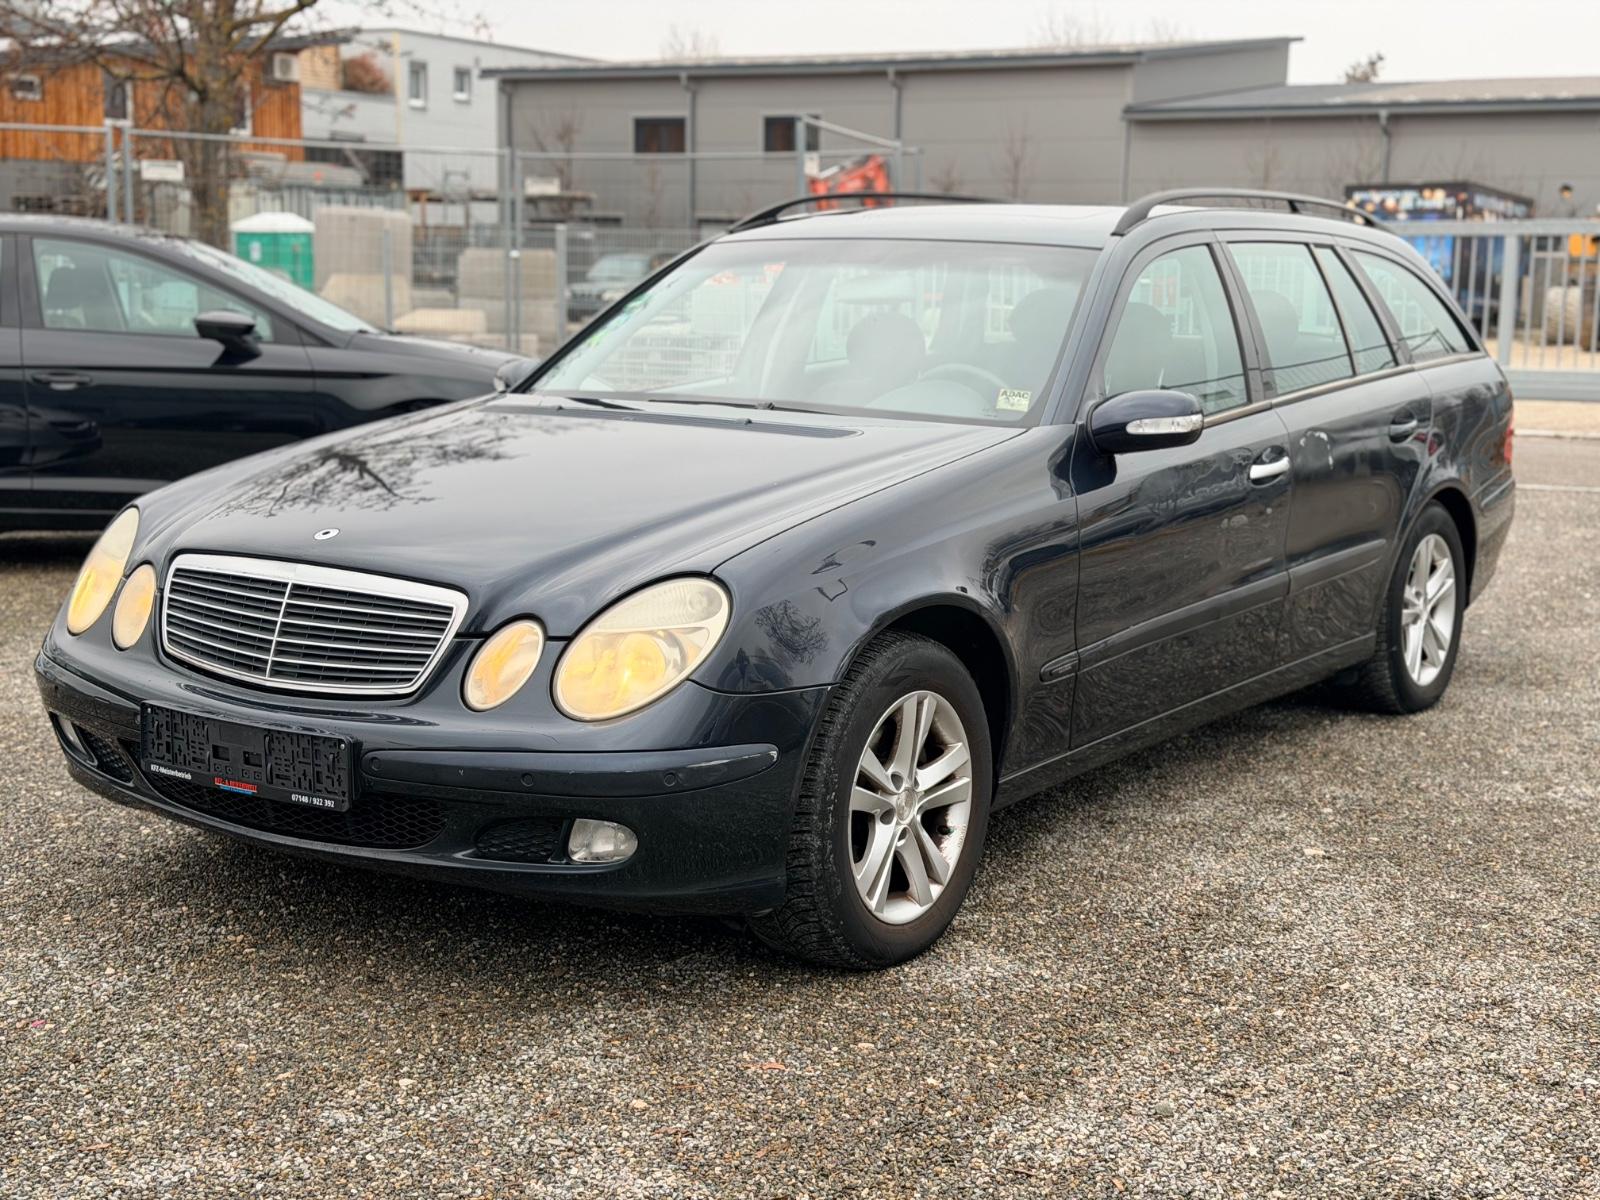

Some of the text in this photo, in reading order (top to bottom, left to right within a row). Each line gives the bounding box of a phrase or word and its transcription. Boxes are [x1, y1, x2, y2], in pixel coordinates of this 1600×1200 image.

[1001, 390, 1029, 399] ADAC
[150, 764, 192, 780] KFZ-Meisterbetrieb
[291, 794, 308, 803] 07148
[312, 797, 323, 805] 922
[324, 799, 334, 807] 392
